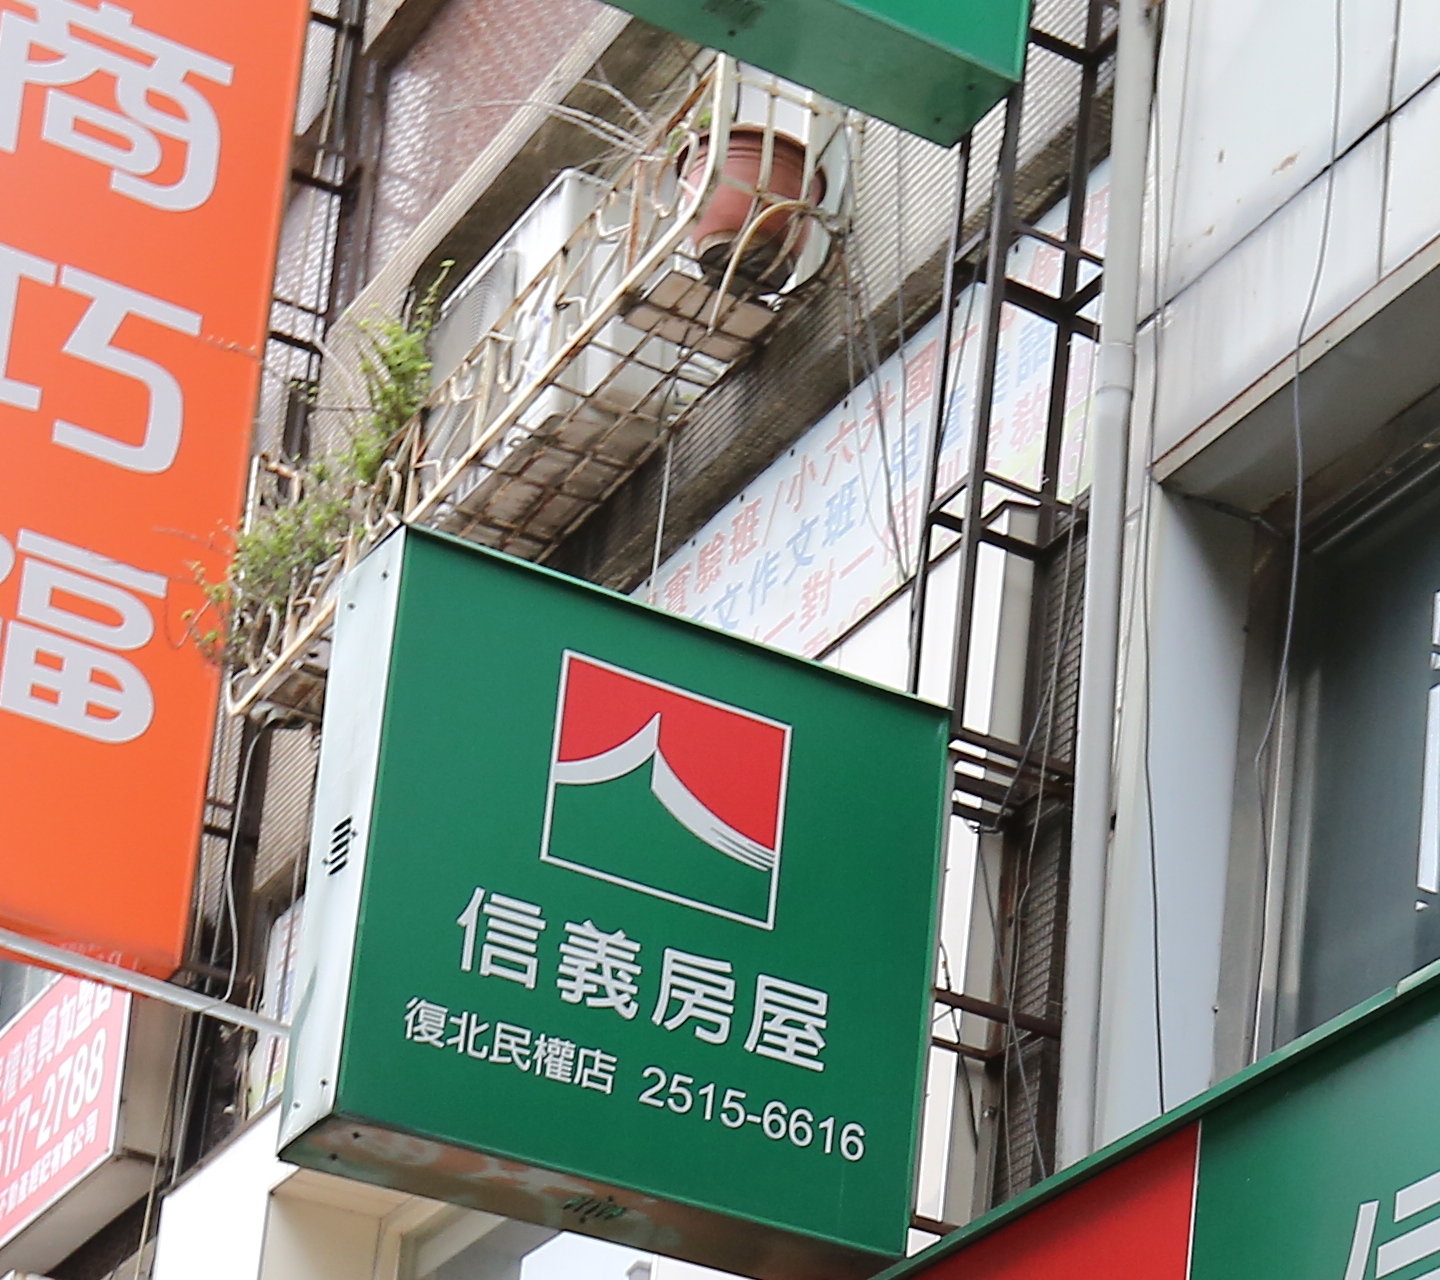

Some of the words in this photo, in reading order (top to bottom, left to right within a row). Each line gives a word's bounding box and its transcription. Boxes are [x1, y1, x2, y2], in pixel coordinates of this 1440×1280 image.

[456, 886, 830, 1074] 信義房屋
[403, 998, 618, 1096] 復北民權店
[639, 1066, 865, 1162] 2515-6616
